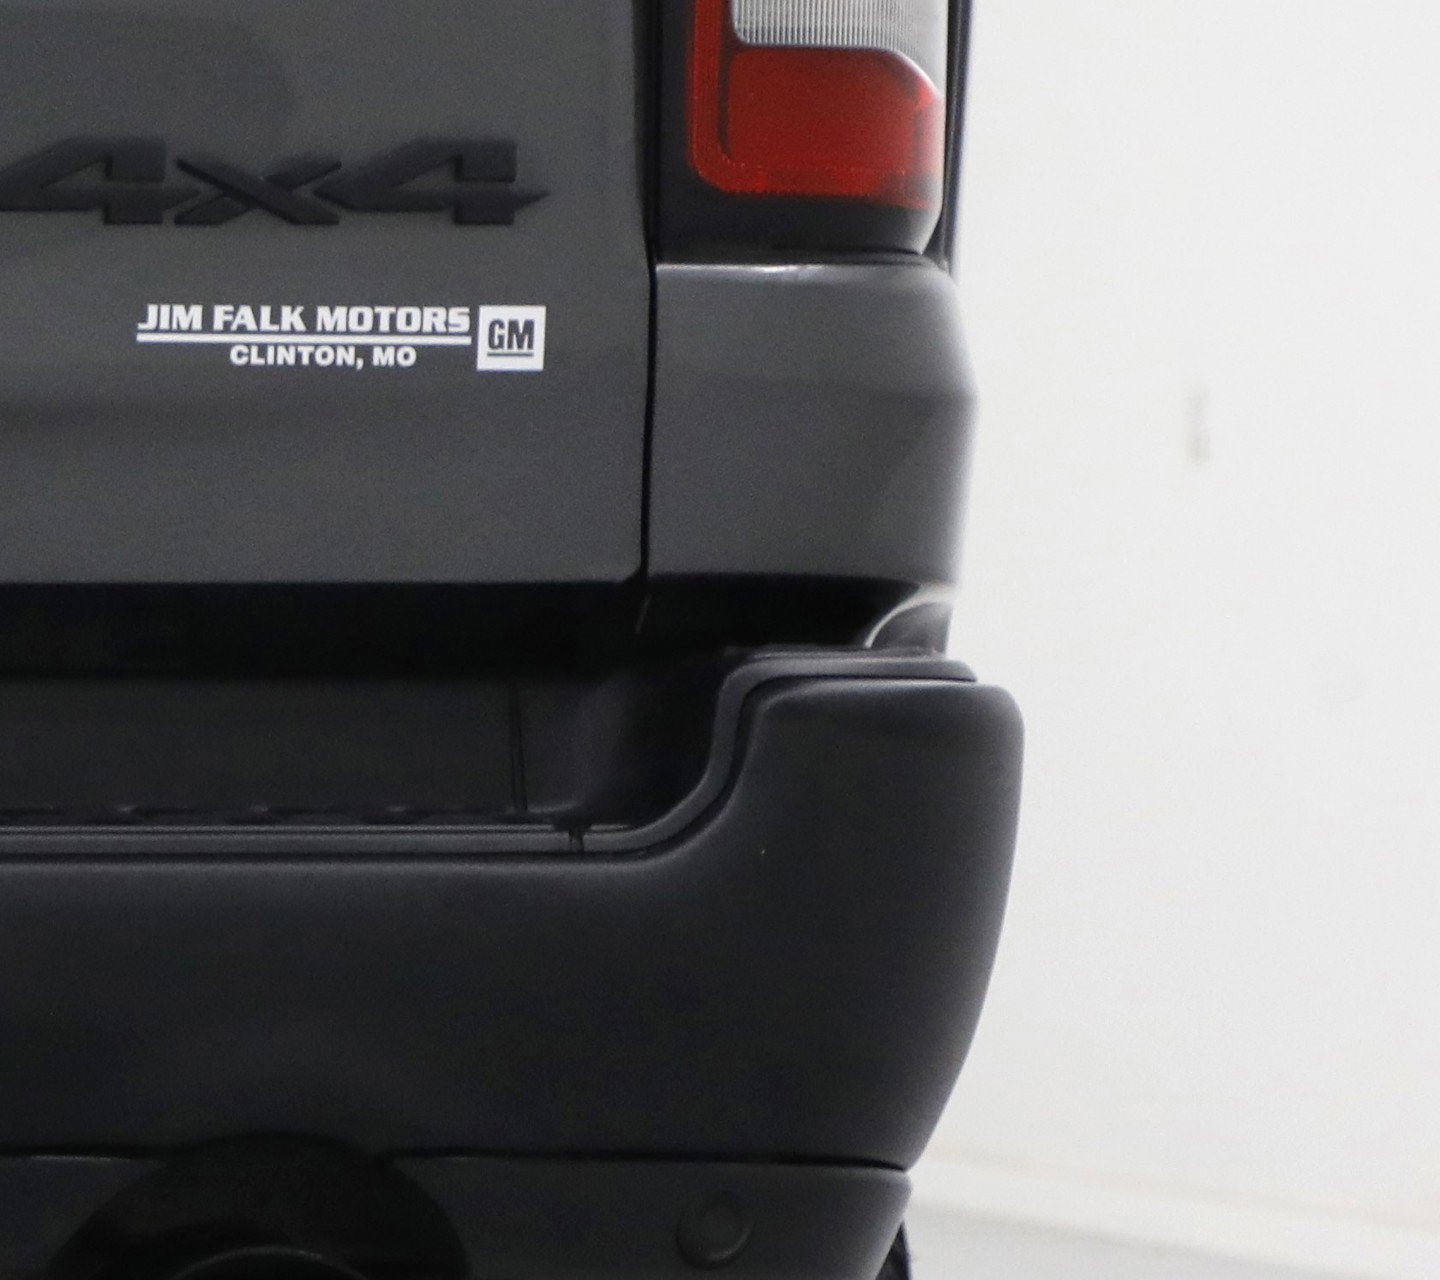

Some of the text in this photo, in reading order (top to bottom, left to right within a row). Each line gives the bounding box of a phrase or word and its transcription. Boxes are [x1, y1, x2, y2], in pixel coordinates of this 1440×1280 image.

[137, 304, 472, 334] JIM FALK MOTORS
[486, 318, 535, 354] GM
[229, 345, 417, 371] CLINTON, MO
